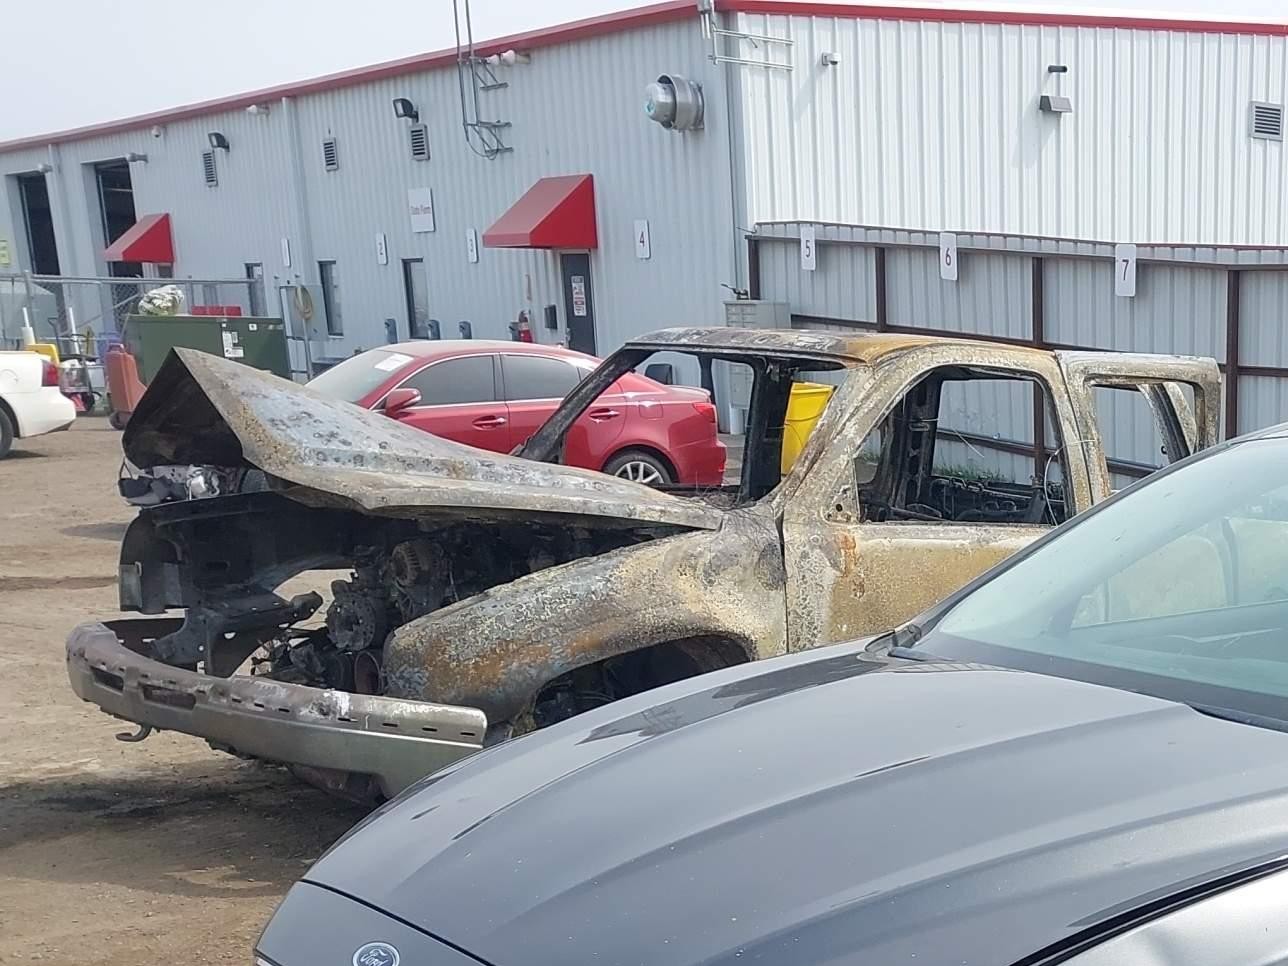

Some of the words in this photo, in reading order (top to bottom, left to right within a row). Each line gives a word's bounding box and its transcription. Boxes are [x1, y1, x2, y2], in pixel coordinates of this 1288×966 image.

[639, 231, 645, 248] 4
[805, 239, 811, 258] 5
[945, 248, 952, 266] 6
[1122, 259, 1129, 281] 7
